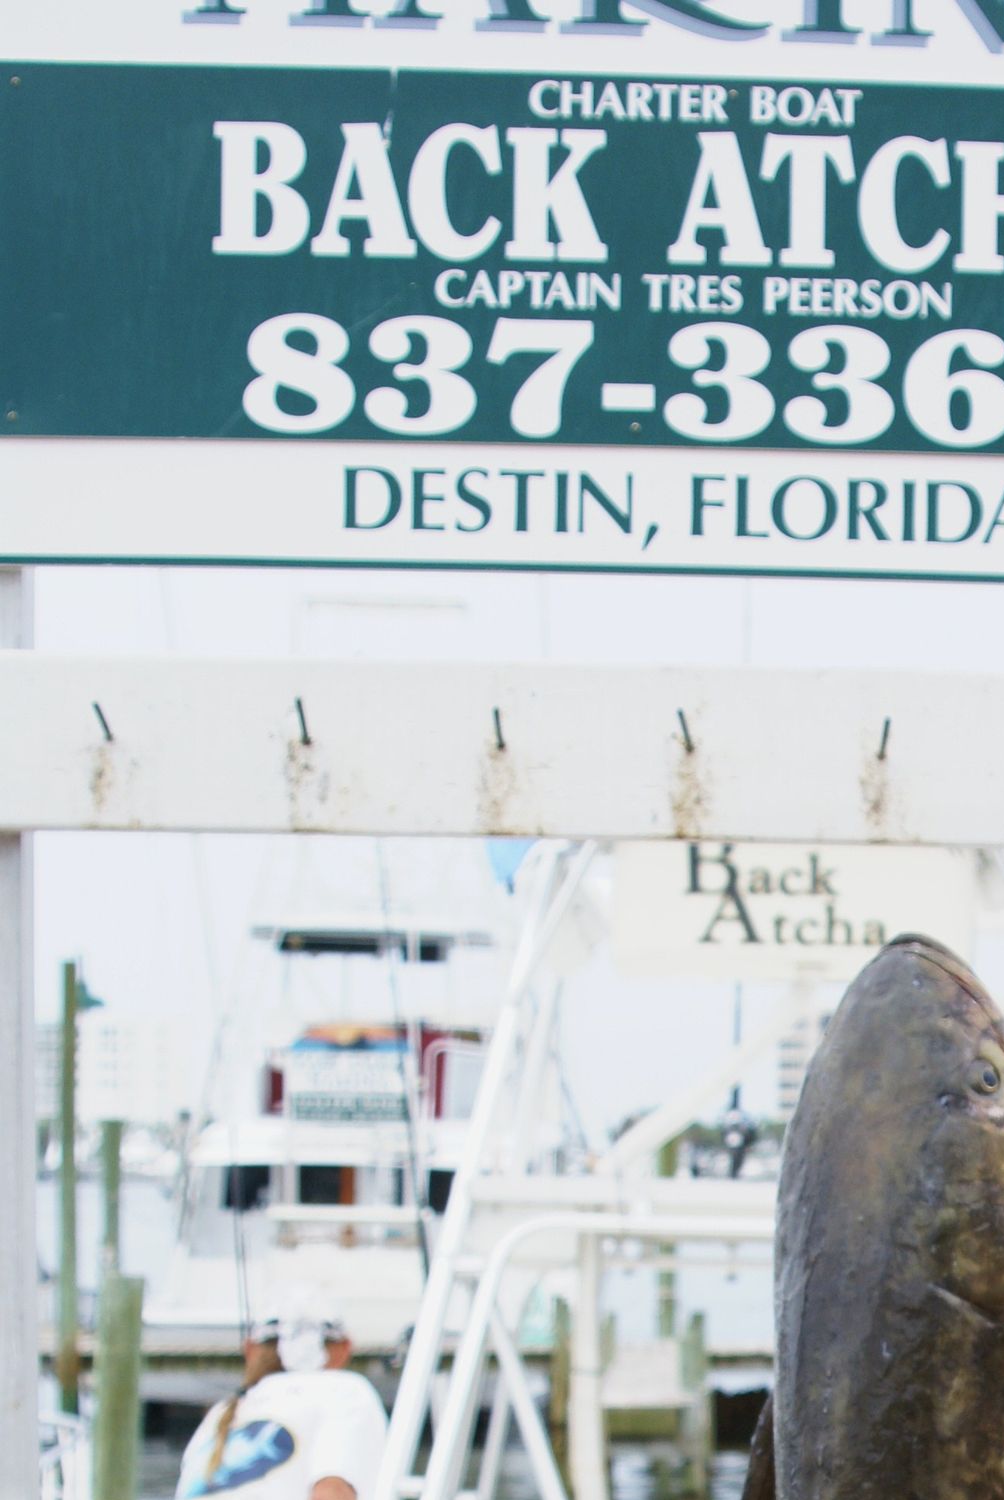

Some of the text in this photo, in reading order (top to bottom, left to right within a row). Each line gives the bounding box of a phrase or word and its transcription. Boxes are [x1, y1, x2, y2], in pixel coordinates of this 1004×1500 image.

[529, 79, 862, 125] CHARTER BOAT
[212, 120, 608, 262] BACK
[435, 269, 952, 318] CAPTAIN TRES PEERSON
[343, 467, 659, 550] DESTIN,
[685, 842, 837, 896] Back
[698, 894, 886, 946] Atcha
